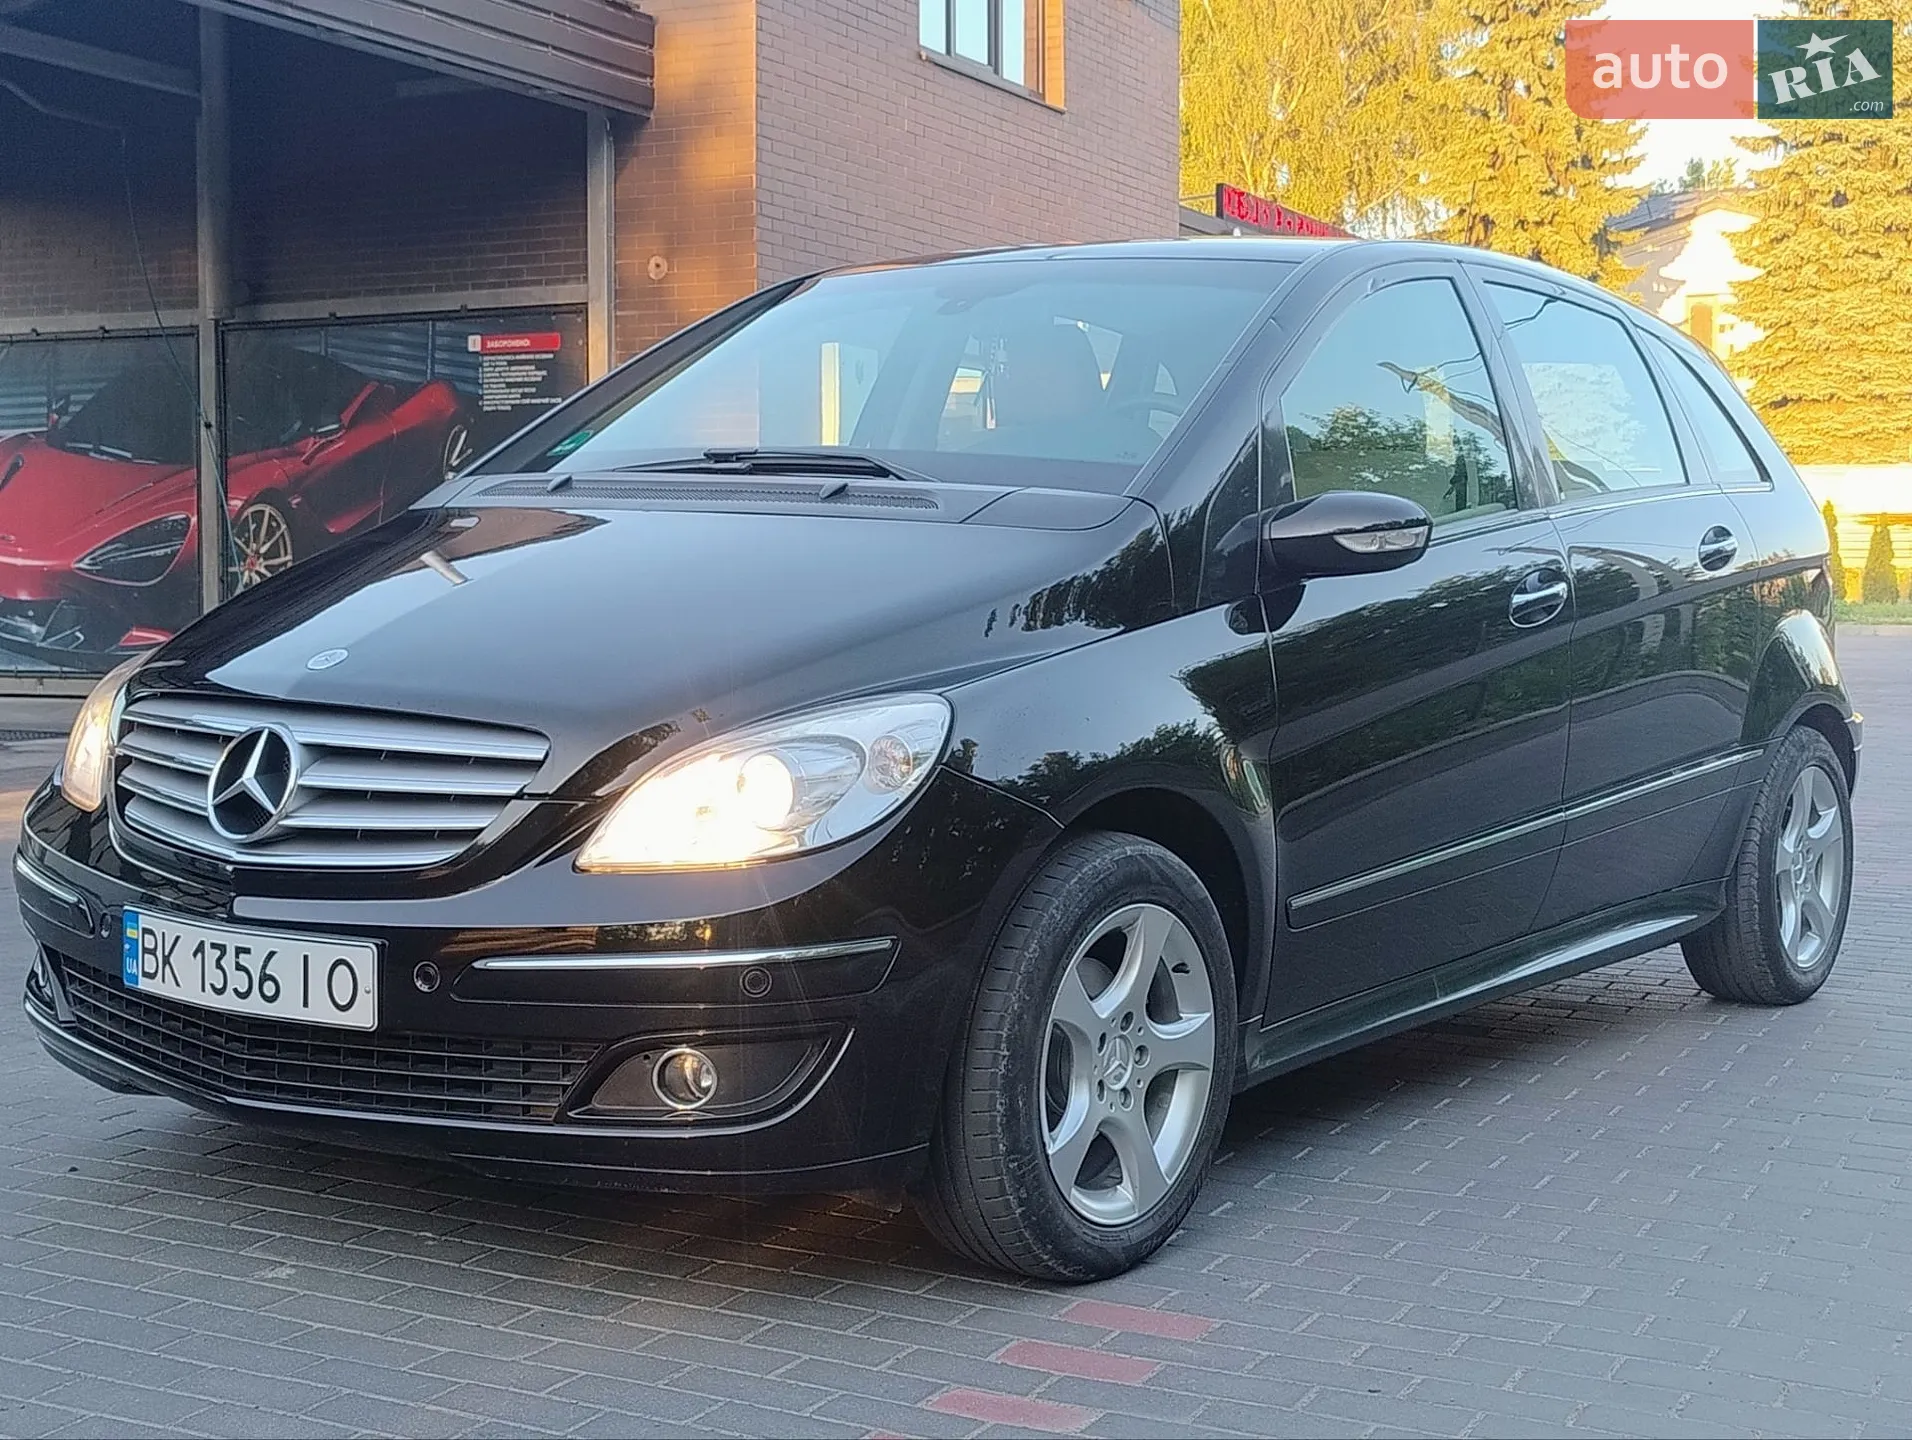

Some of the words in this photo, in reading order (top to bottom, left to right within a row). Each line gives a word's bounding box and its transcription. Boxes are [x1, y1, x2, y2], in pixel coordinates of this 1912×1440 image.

[126, 957, 138, 976] UA
[141, 927, 181, 988] BK
[191, 939, 281, 1004] 1356
